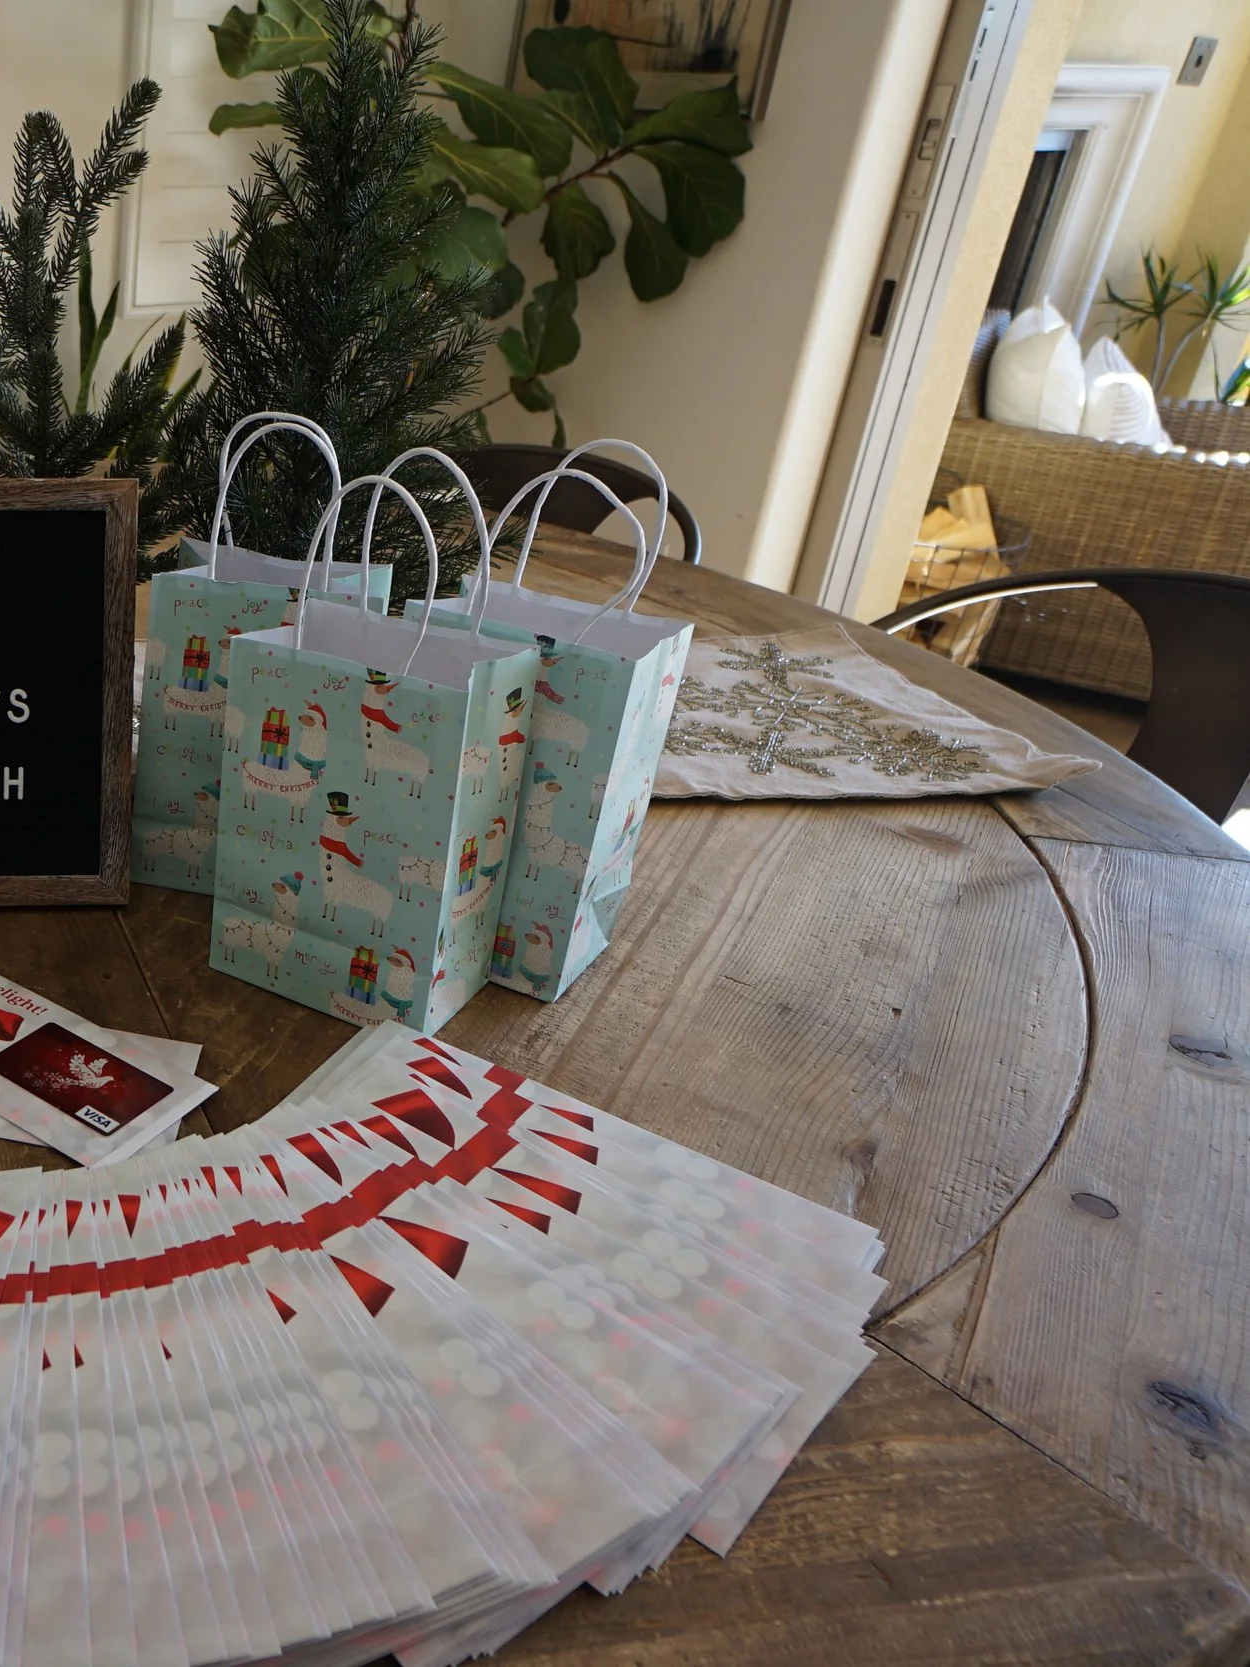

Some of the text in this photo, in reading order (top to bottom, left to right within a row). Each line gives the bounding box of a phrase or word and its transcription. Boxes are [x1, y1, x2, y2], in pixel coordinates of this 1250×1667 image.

[241, 599, 264, 615] joy
[323, 673, 346, 692] joy
[167, 697, 228, 713] MERRY CHRIST
[245, 773, 320, 794] MERRY CHRISTMAS
[83, 1107, 112, 1129] VISA
